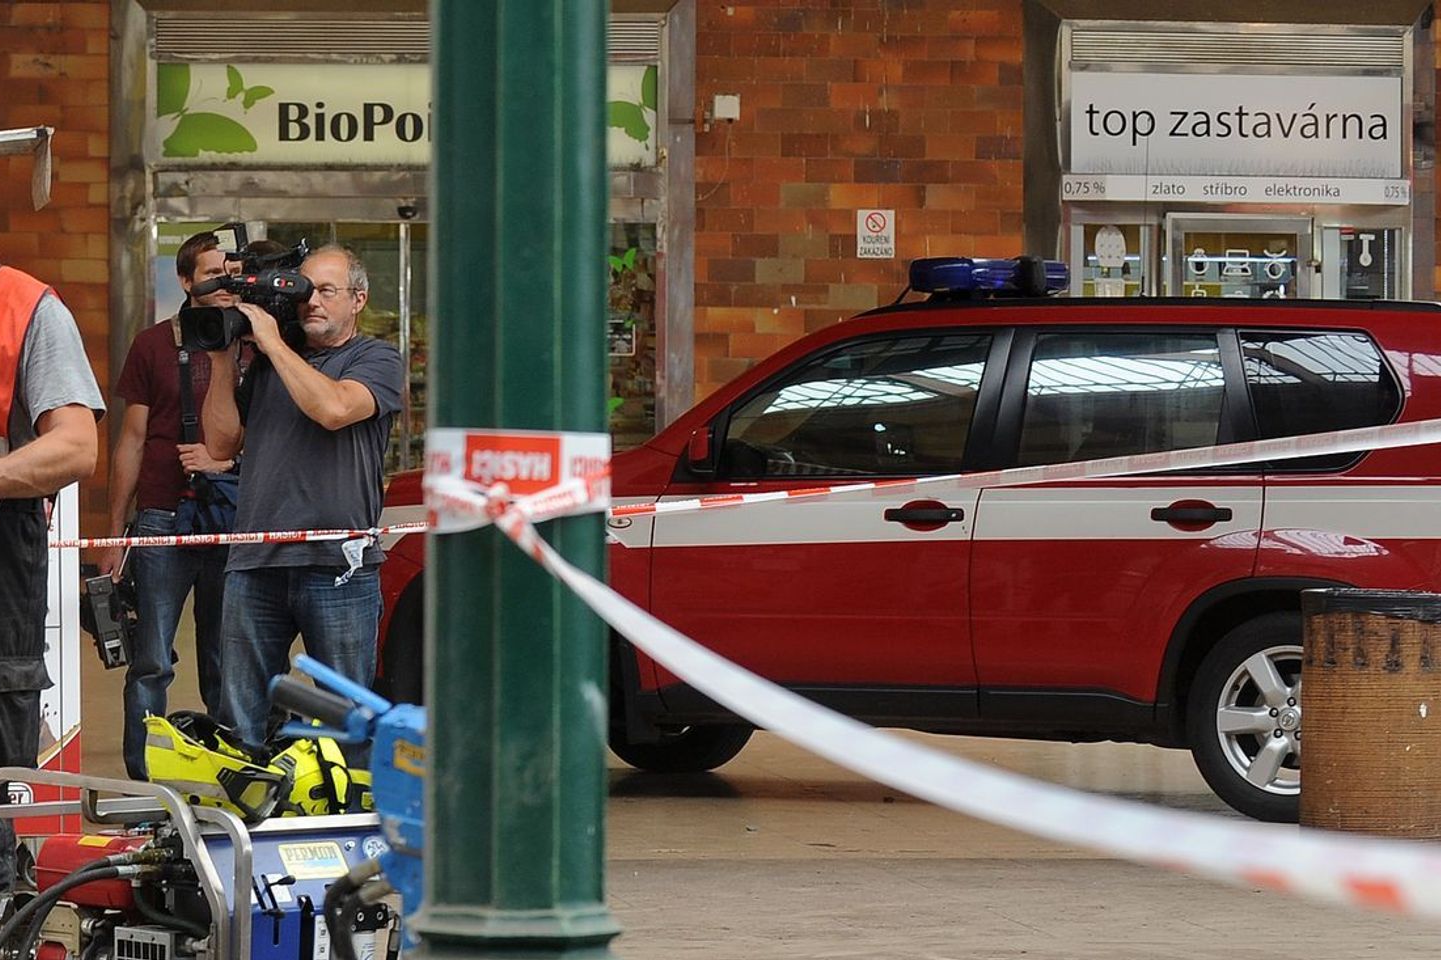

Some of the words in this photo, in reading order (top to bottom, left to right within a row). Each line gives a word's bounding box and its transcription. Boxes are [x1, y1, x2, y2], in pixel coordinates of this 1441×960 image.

[1086, 104, 1156, 146] top
[1169, 103, 1388, 140] zastavárna
[1064, 181, 1090, 196] 0,75
[1152, 182, 1186, 196] zlato
[1203, 183, 1248, 196] stříbro
[1265, 184, 1341, 198] elektronika
